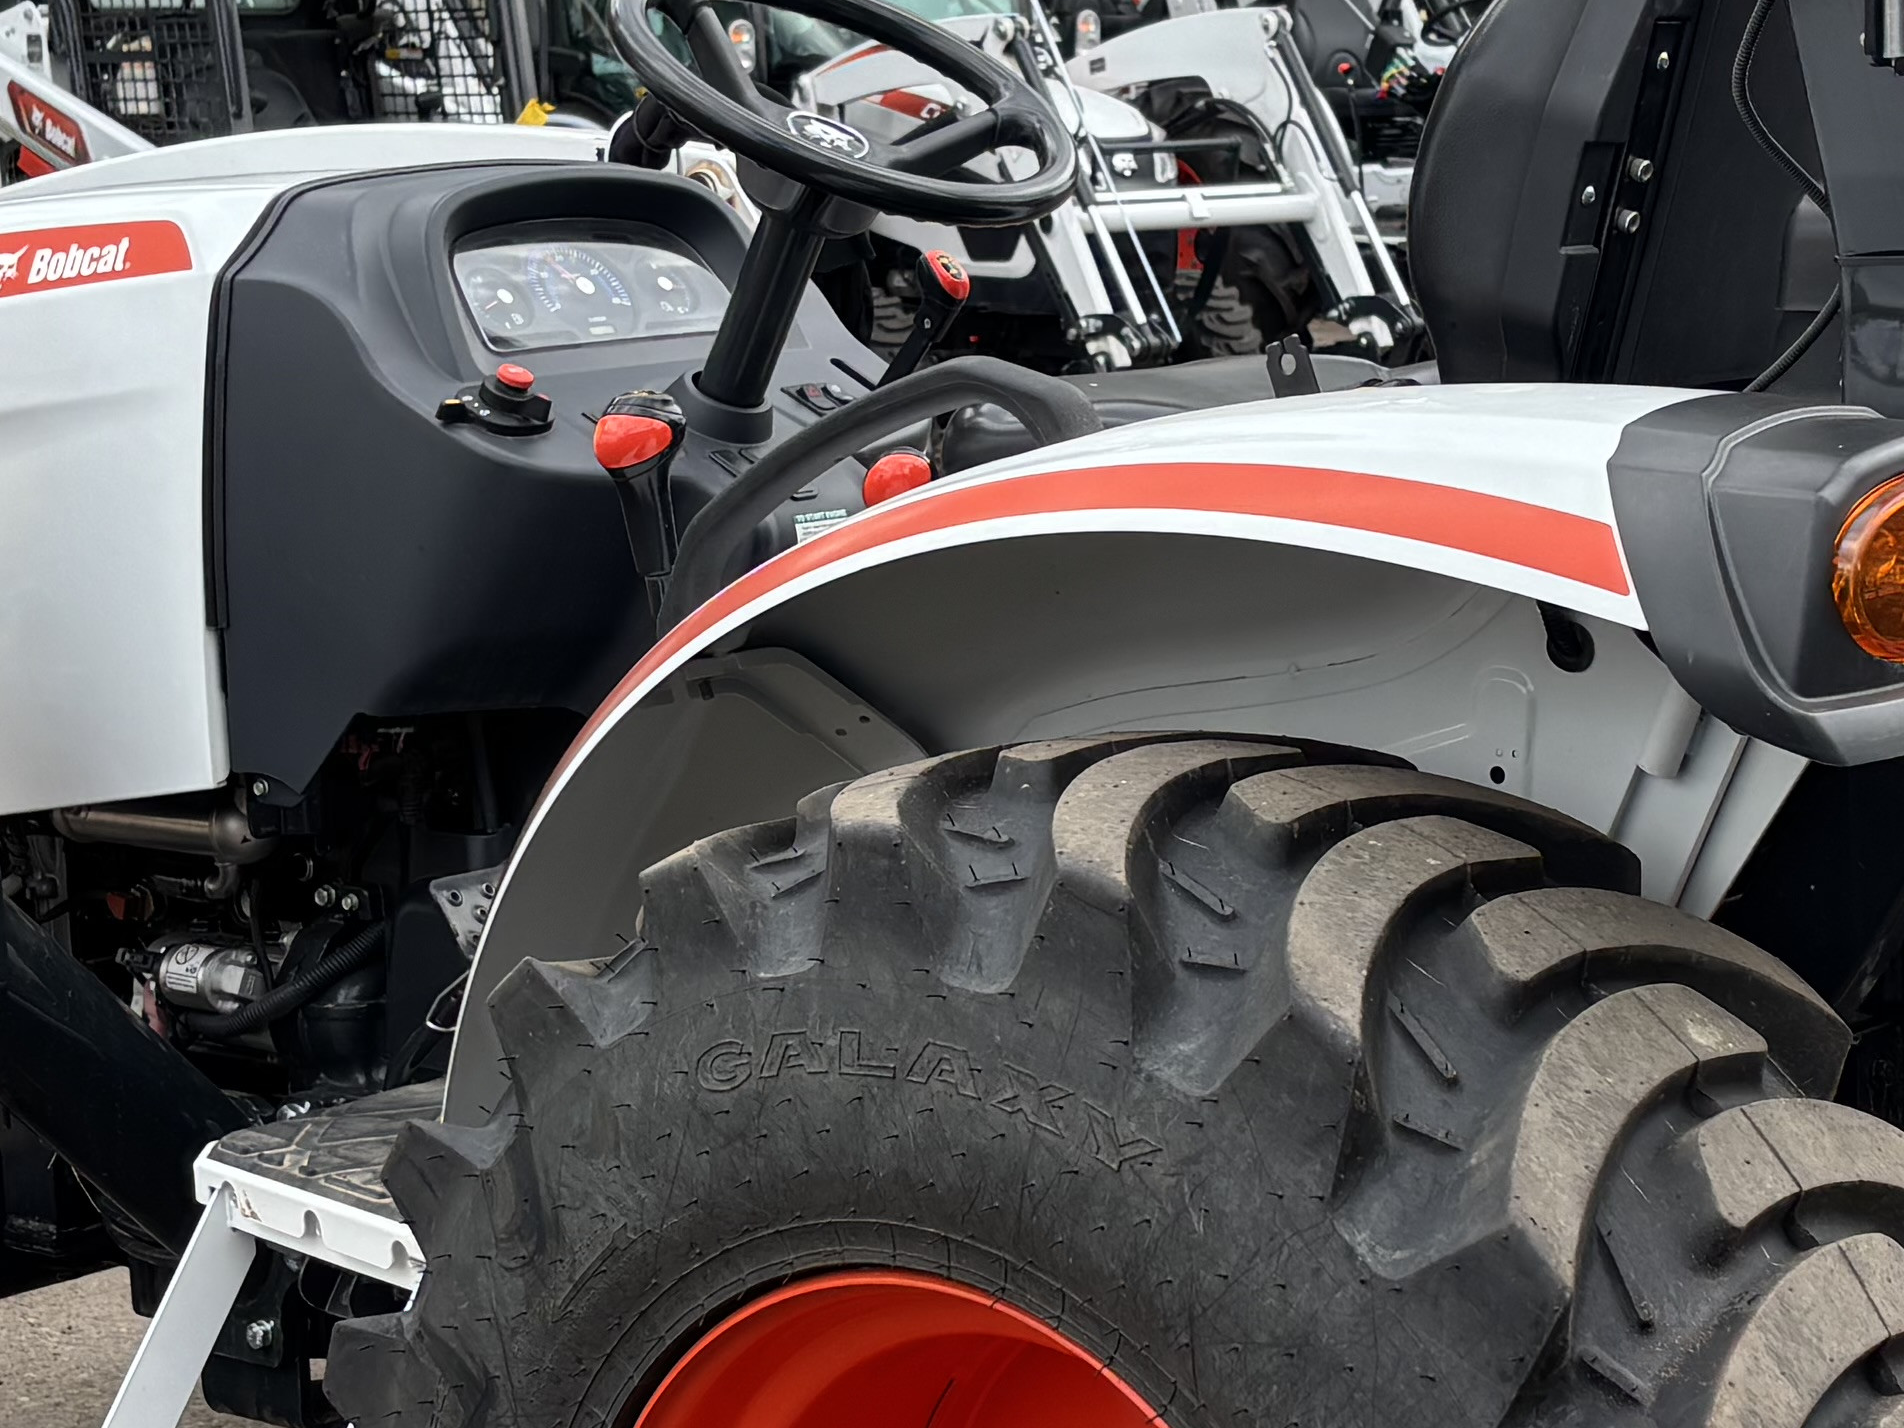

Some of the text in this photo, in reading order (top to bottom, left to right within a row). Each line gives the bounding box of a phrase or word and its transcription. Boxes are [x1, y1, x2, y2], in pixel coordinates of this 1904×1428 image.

[45, 117, 76, 159] Bobcat
[27, 236, 130, 284] Bobcat
[696, 1029, 1164, 1173] GALAXY
